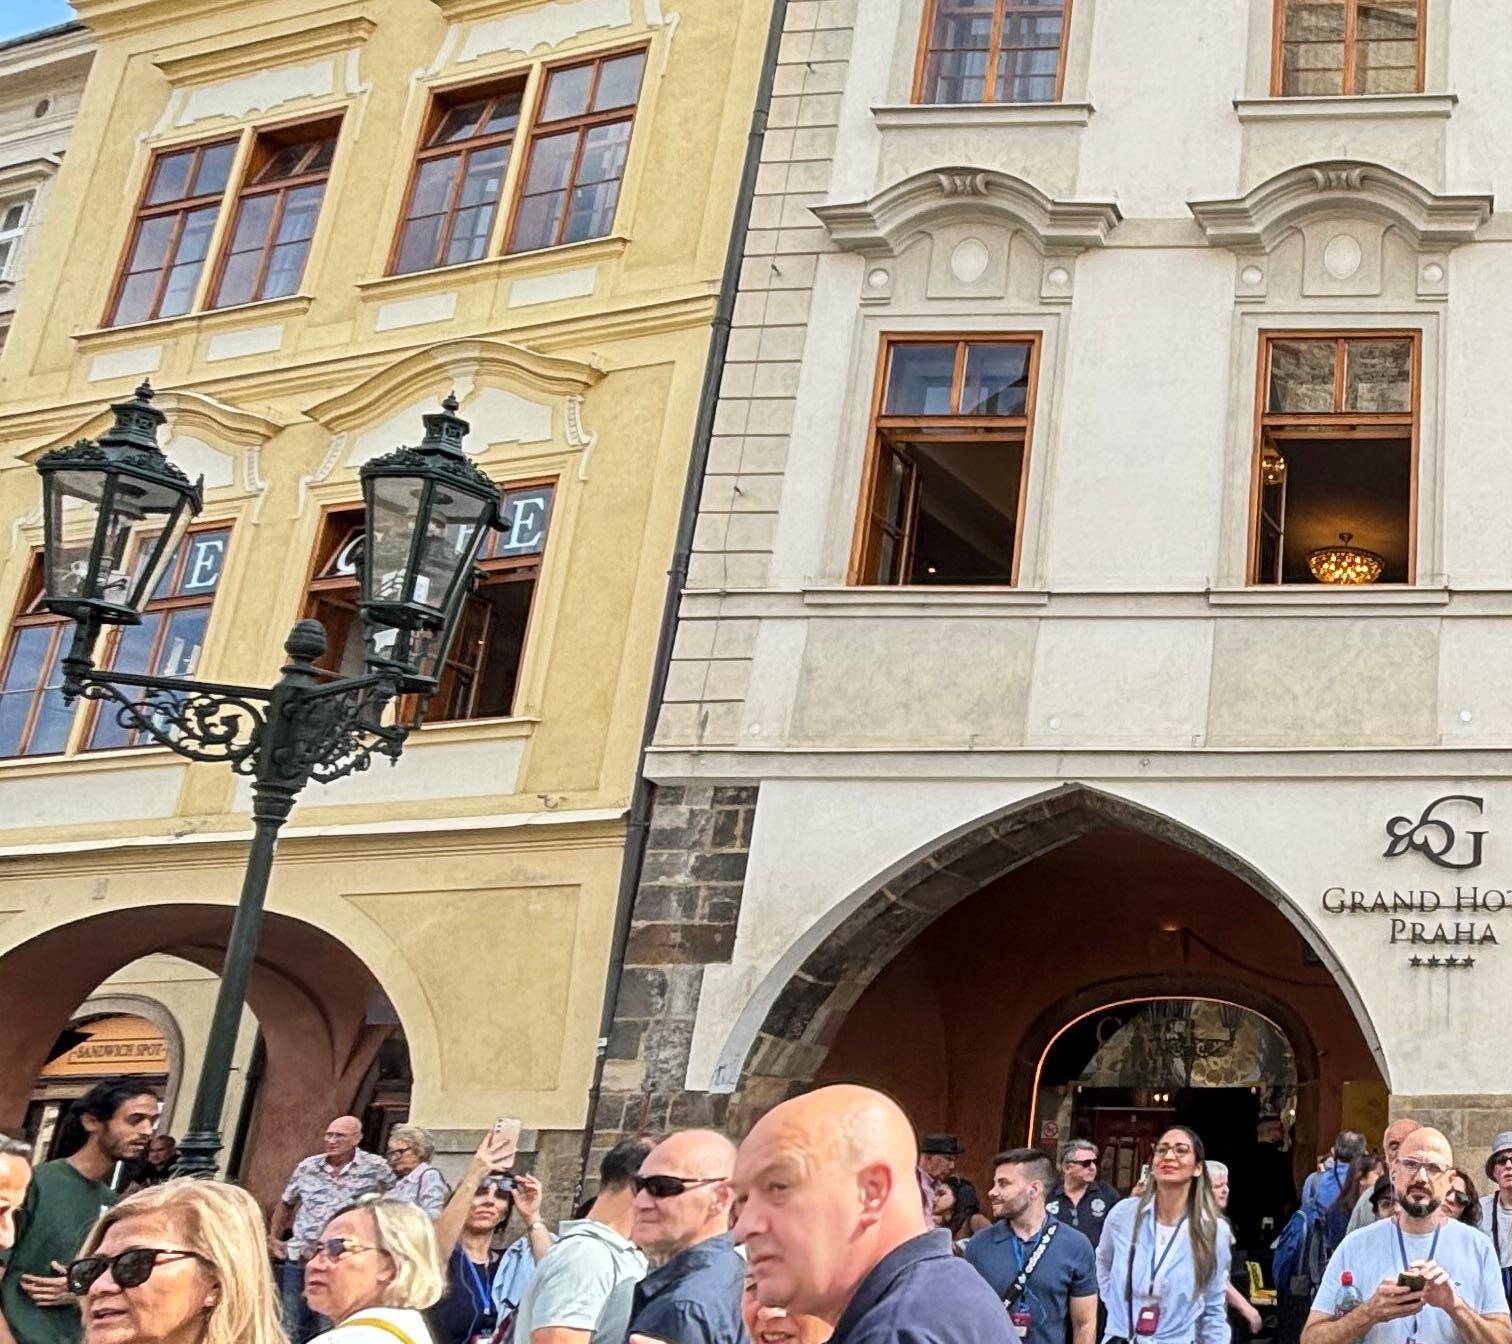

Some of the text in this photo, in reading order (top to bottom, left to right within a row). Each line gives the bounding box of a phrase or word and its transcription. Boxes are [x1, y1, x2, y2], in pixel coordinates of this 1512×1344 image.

[1323, 887, 1440, 913] GRAND
[1390, 918, 1500, 945] PRAHA
[136, 1043, 163, 1057] SPOT
